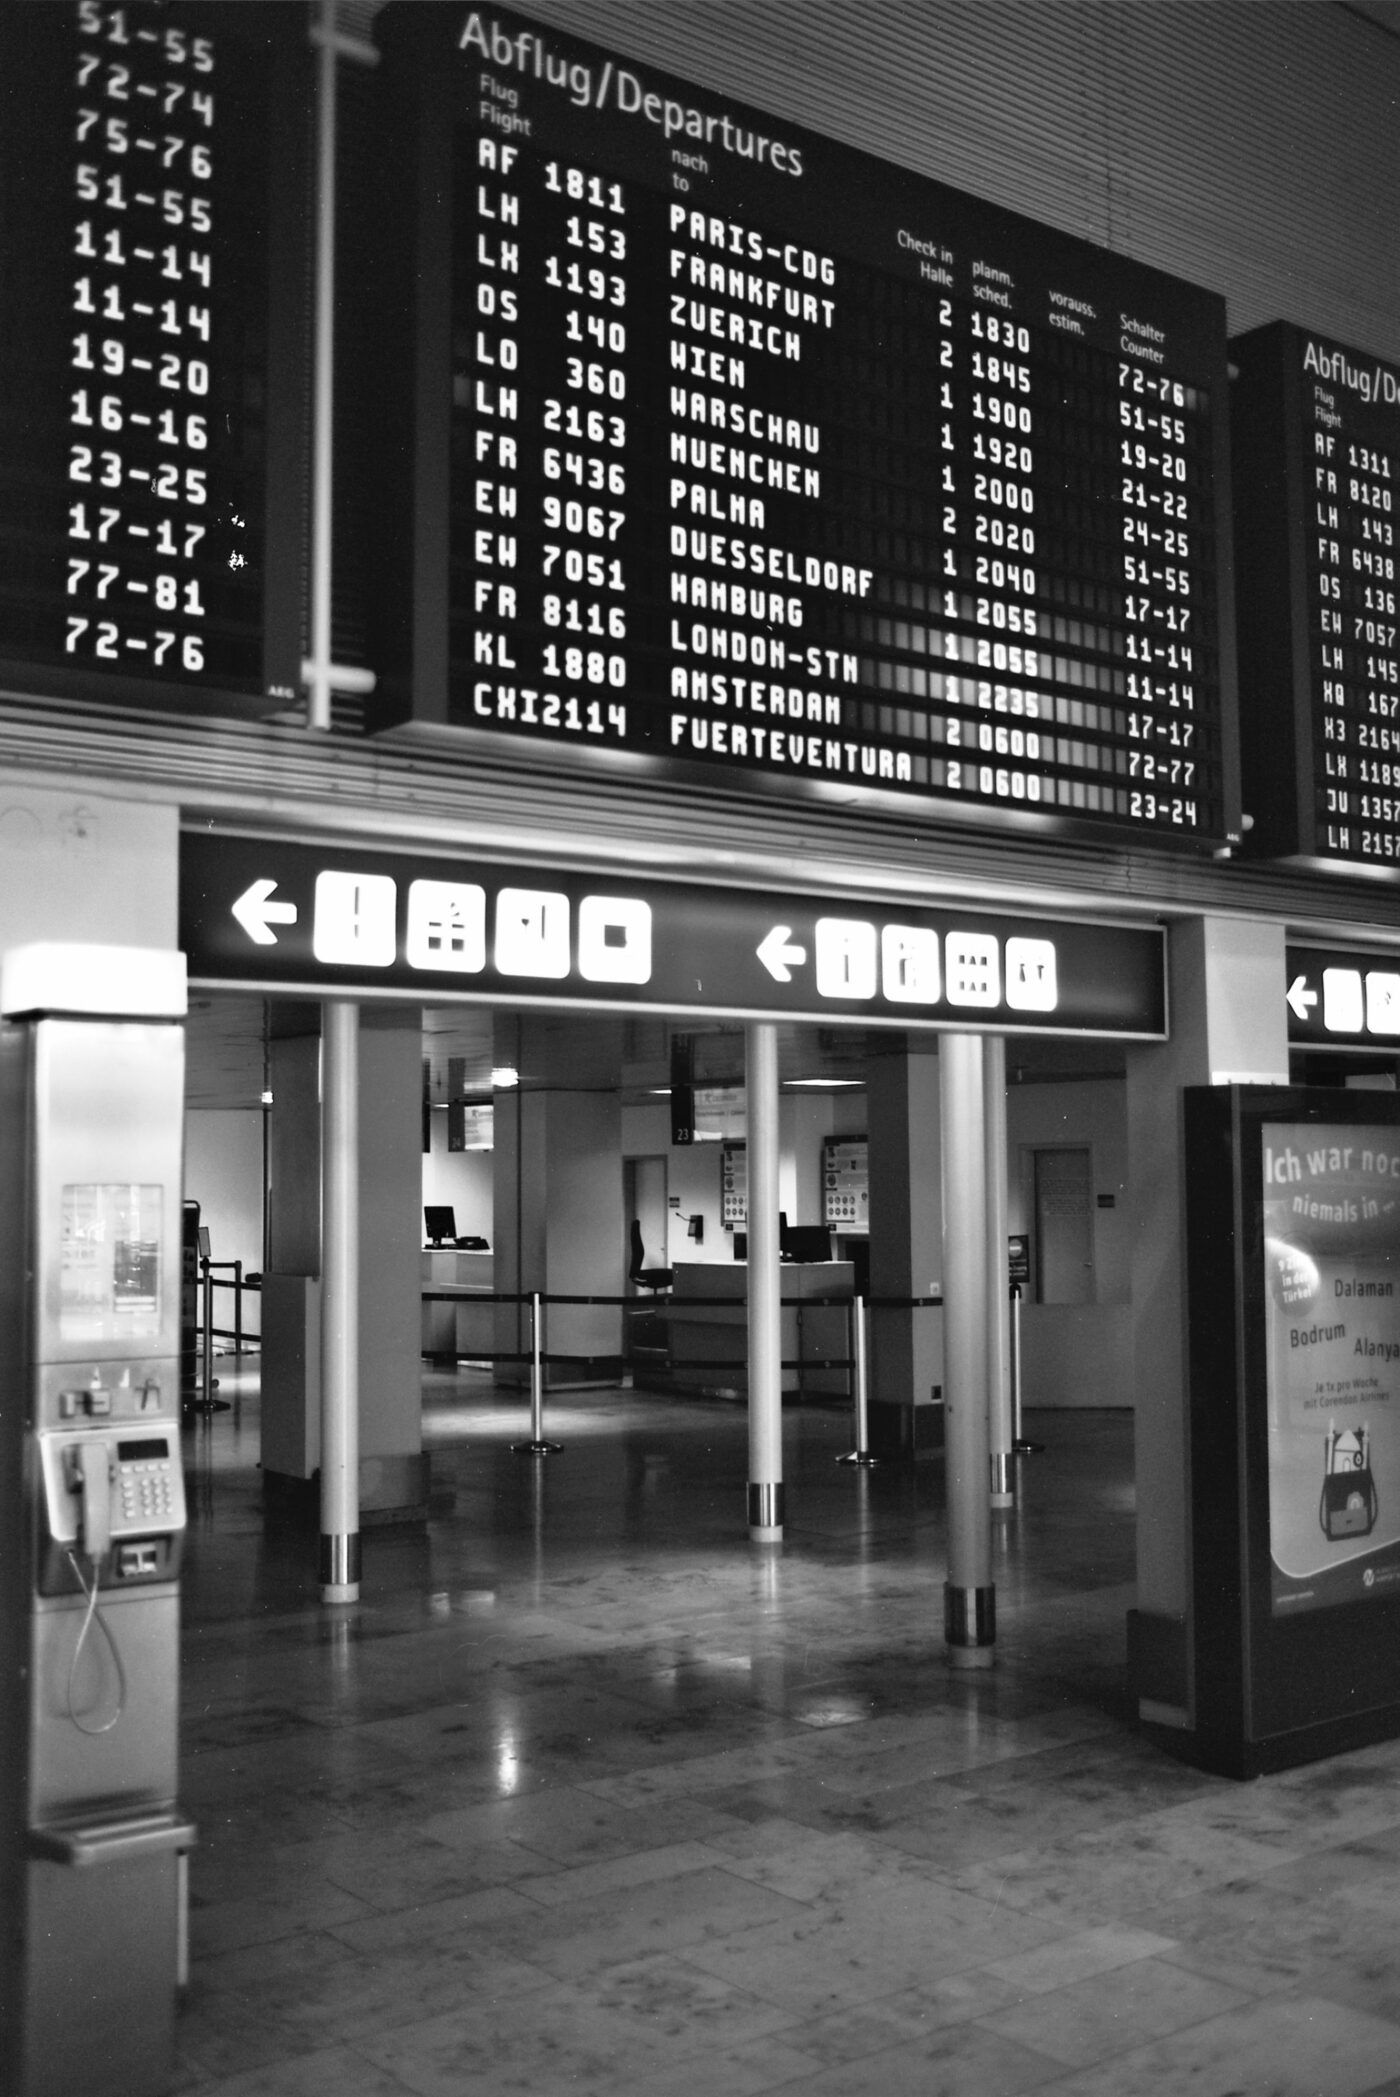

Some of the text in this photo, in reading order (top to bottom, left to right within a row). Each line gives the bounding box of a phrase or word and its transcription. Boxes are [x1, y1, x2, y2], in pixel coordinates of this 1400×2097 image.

[78, 0, 214, 73] 51-55
[78, 57, 213, 126] 72-74
[459, 12, 803, 177] Abflug/Departures
[479, 73, 518, 108] Flug
[479, 103, 532, 137] Flight
[77, 110, 212, 179] 75-76
[671, 148, 709, 173] nach
[77, 164, 211, 233] 51-55
[672, 172, 689, 192] to
[74, 221, 211, 288] 11-14
[897, 229, 953, 264] Check in
[479, 139, 1183, 406] AF 1811 PARIS-CDG 2 1830 72-76
[920, 261, 953, 288] Halle
[972, 260, 1015, 288] planm.
[73, 277, 210, 342] 11-14
[479, 186, 1184, 443] LH 153 FRANKFURT 2 1845 51-55
[973, 284, 1012, 309] sched.
[1049, 290, 1097, 318] vorauss.
[1048, 311, 1085, 335] estim.
[1120, 314, 1165, 344] Schalter
[72, 333, 209, 396] 19-20
[546, 257, 625, 306] 1193
[671, 295, 799, 360] ZUERICH
[940, 382, 954, 409] 1
[973, 394, 1031, 432] 1900
[1122, 441, 1185, 481] 19-20
[1120, 337, 1164, 364] Counter
[478, 284, 1187, 519] OS 140 WIEN 1 1920 21-22
[1314, 385, 1334, 409] Flug
[1315, 405, 1341, 428] Flight
[70, 389, 208, 450] 16-16
[477, 332, 1188, 556] LO 360 WARSCHAU 1 2000 24-25
[1315, 433, 1390, 477] AF 1311
[69, 445, 207, 505] 23-25
[477, 381, 1189, 594] LH 2163 MUENCHEN 2 2020 51-55
[1316, 468, 1391, 511] FR 8120
[68, 502, 206, 558] 17-17
[477, 431, 1189, 631] FR 6436 PALMA 1 2040 17-17
[1318, 503, 1392, 545] LH 143
[476, 480, 1191, 671] EW 9067 DUESSELDORF 1 2055 11-14
[1319, 538, 1393, 579] FR 6438
[67, 558, 205, 616] 77-81
[1320, 574, 1395, 614] OS 136
[476, 530, 1192, 709] EW 7051 HAMBURG 1 2055 11-14
[1321, 609, 1395, 647] EW 7057
[66, 616, 204, 671] 72-76
[476, 581, 516, 618] FR
[544, 595, 625, 638] 8116
[946, 676, 959, 703] 1
[980, 683, 1037, 716] 2235
[1129, 713, 1192, 746] 17-17
[1323, 645, 1397, 683] LH 145
[475, 631, 1194, 785] KL 1880 AMSTERDAM 2 0600 72-77
[1369, 692, 1398, 717] 167
[1359, 725, 1400, 752] 2164
[672, 715, 911, 781] FUERTEVENTURA
[947, 761, 961, 789] 2
[981, 768, 1039, 800] 0600
[1131, 793, 1195, 825] 23-24
[1327, 789, 1348, 813] JU
[1329, 826, 1349, 849] LH
[677, 1128, 689, 1141] 23
[1265, 1147, 1301, 1184] Ich
[1306, 1147, 1353, 1176] war
[1292, 1193, 1378, 1223] niemals in
[1335, 1279, 1393, 1297] Dalaman
[1290, 1323, 1346, 1348] Bodrum
[1354, 1338, 1400, 1362] Alanya
[1337, 1381, 1351, 1392] pro
[1352, 1378, 1379, 1388] Woche
